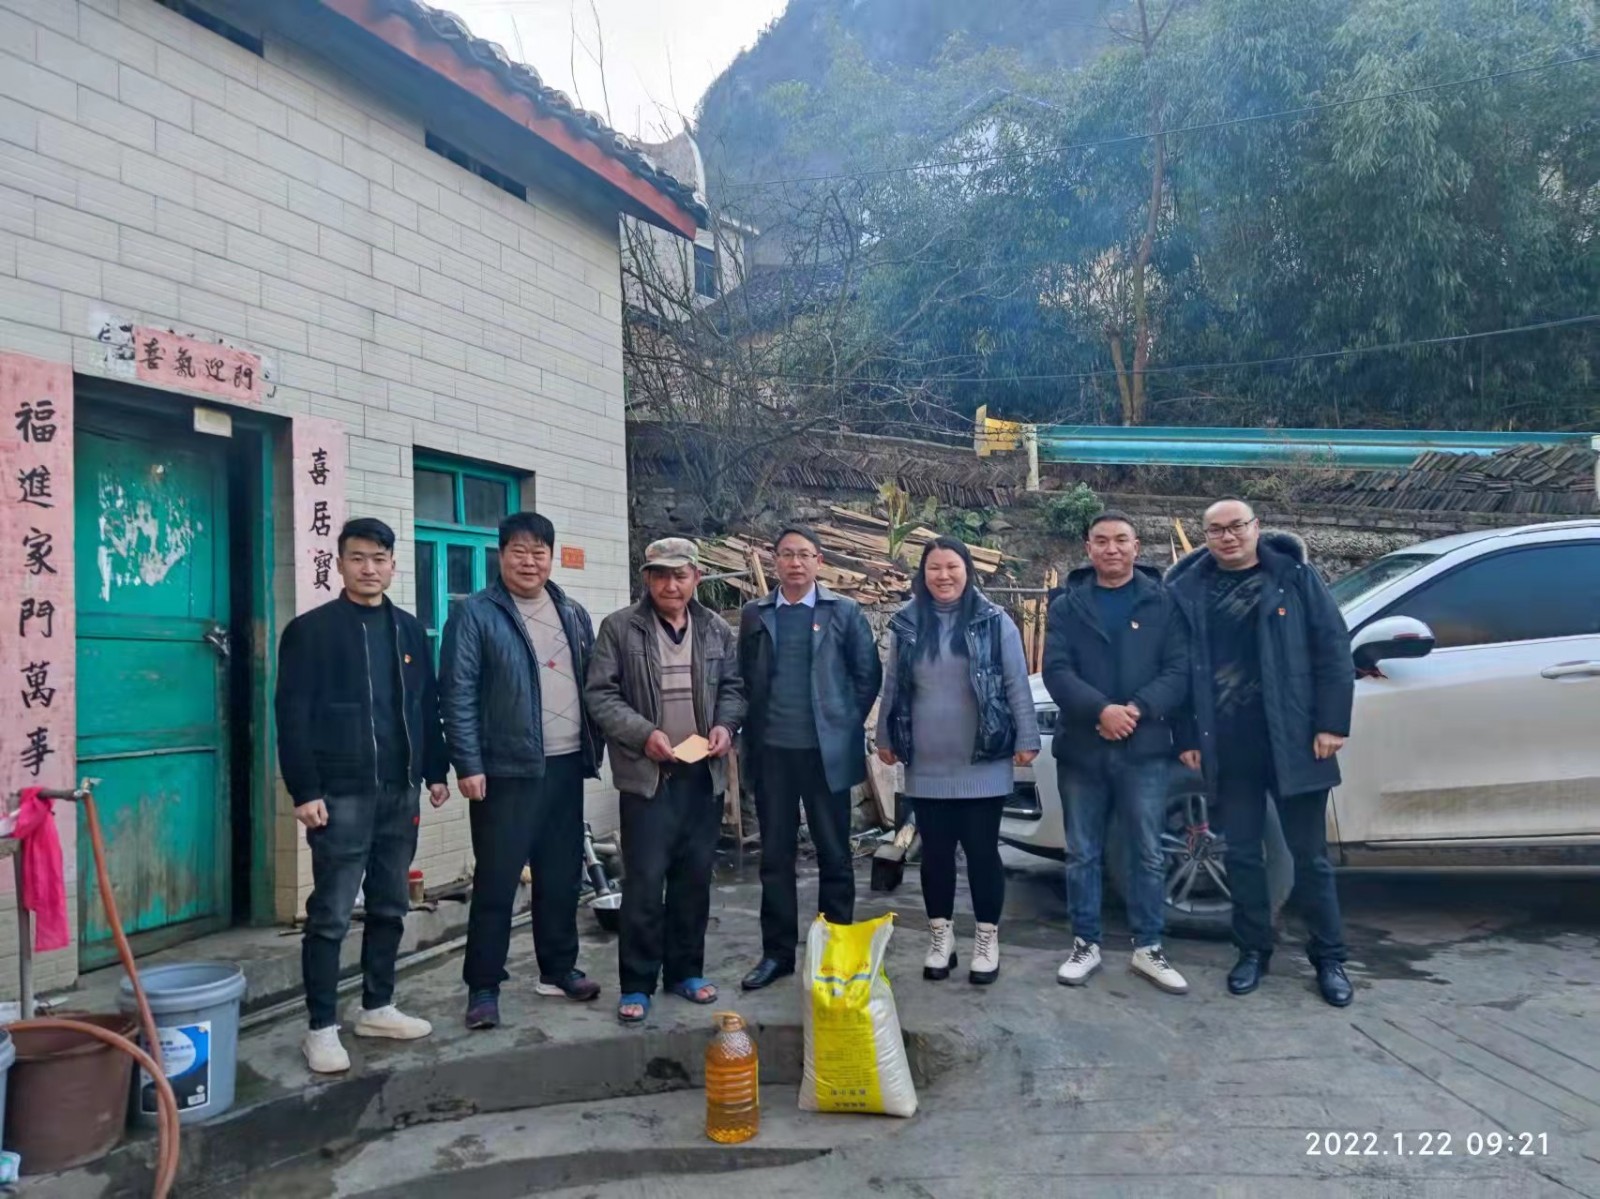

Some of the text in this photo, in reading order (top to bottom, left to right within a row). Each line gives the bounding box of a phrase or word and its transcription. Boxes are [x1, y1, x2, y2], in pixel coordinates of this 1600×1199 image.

[15, 399, 58, 777] 福進家門萬事
